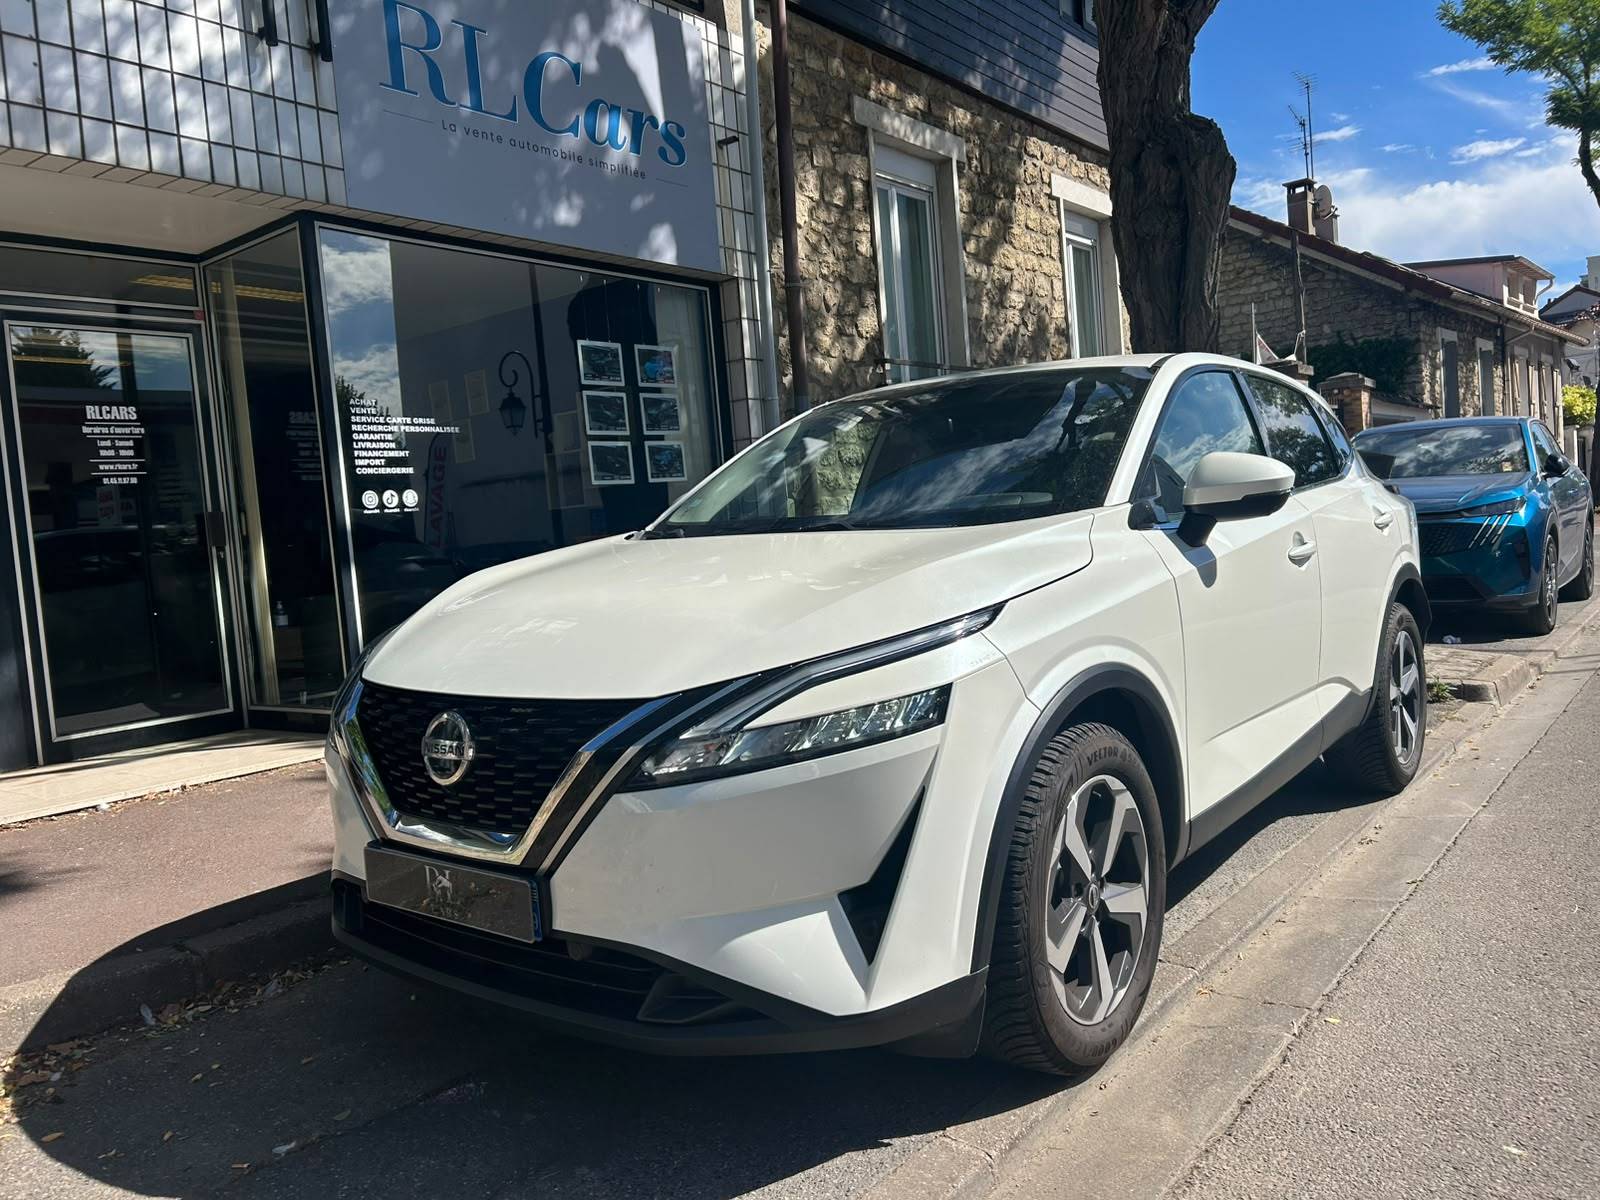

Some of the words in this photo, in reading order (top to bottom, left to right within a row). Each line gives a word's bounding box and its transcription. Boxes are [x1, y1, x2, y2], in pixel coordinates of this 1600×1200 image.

[441, 119, 457, 133] La
[464, 126, 503, 144] vente
[509, 137, 583, 164] automobile
[588, 157, 646, 180] simplifiée
[85, 405, 137, 420] RLCARS
[350, 407, 377, 415] VENTE
[386, 416, 412, 424] CARTE
[413, 417, 436, 425] GRISE
[351, 424, 399, 432] RECHERCHE
[353, 441, 396, 449] LIVRAISON
[354, 450, 410, 458] FINANCEMENT
[355, 458, 386, 466] IMPORT
[424, 740, 465, 757] NISSAN
[1087, 745, 1119, 766] VECTOR
